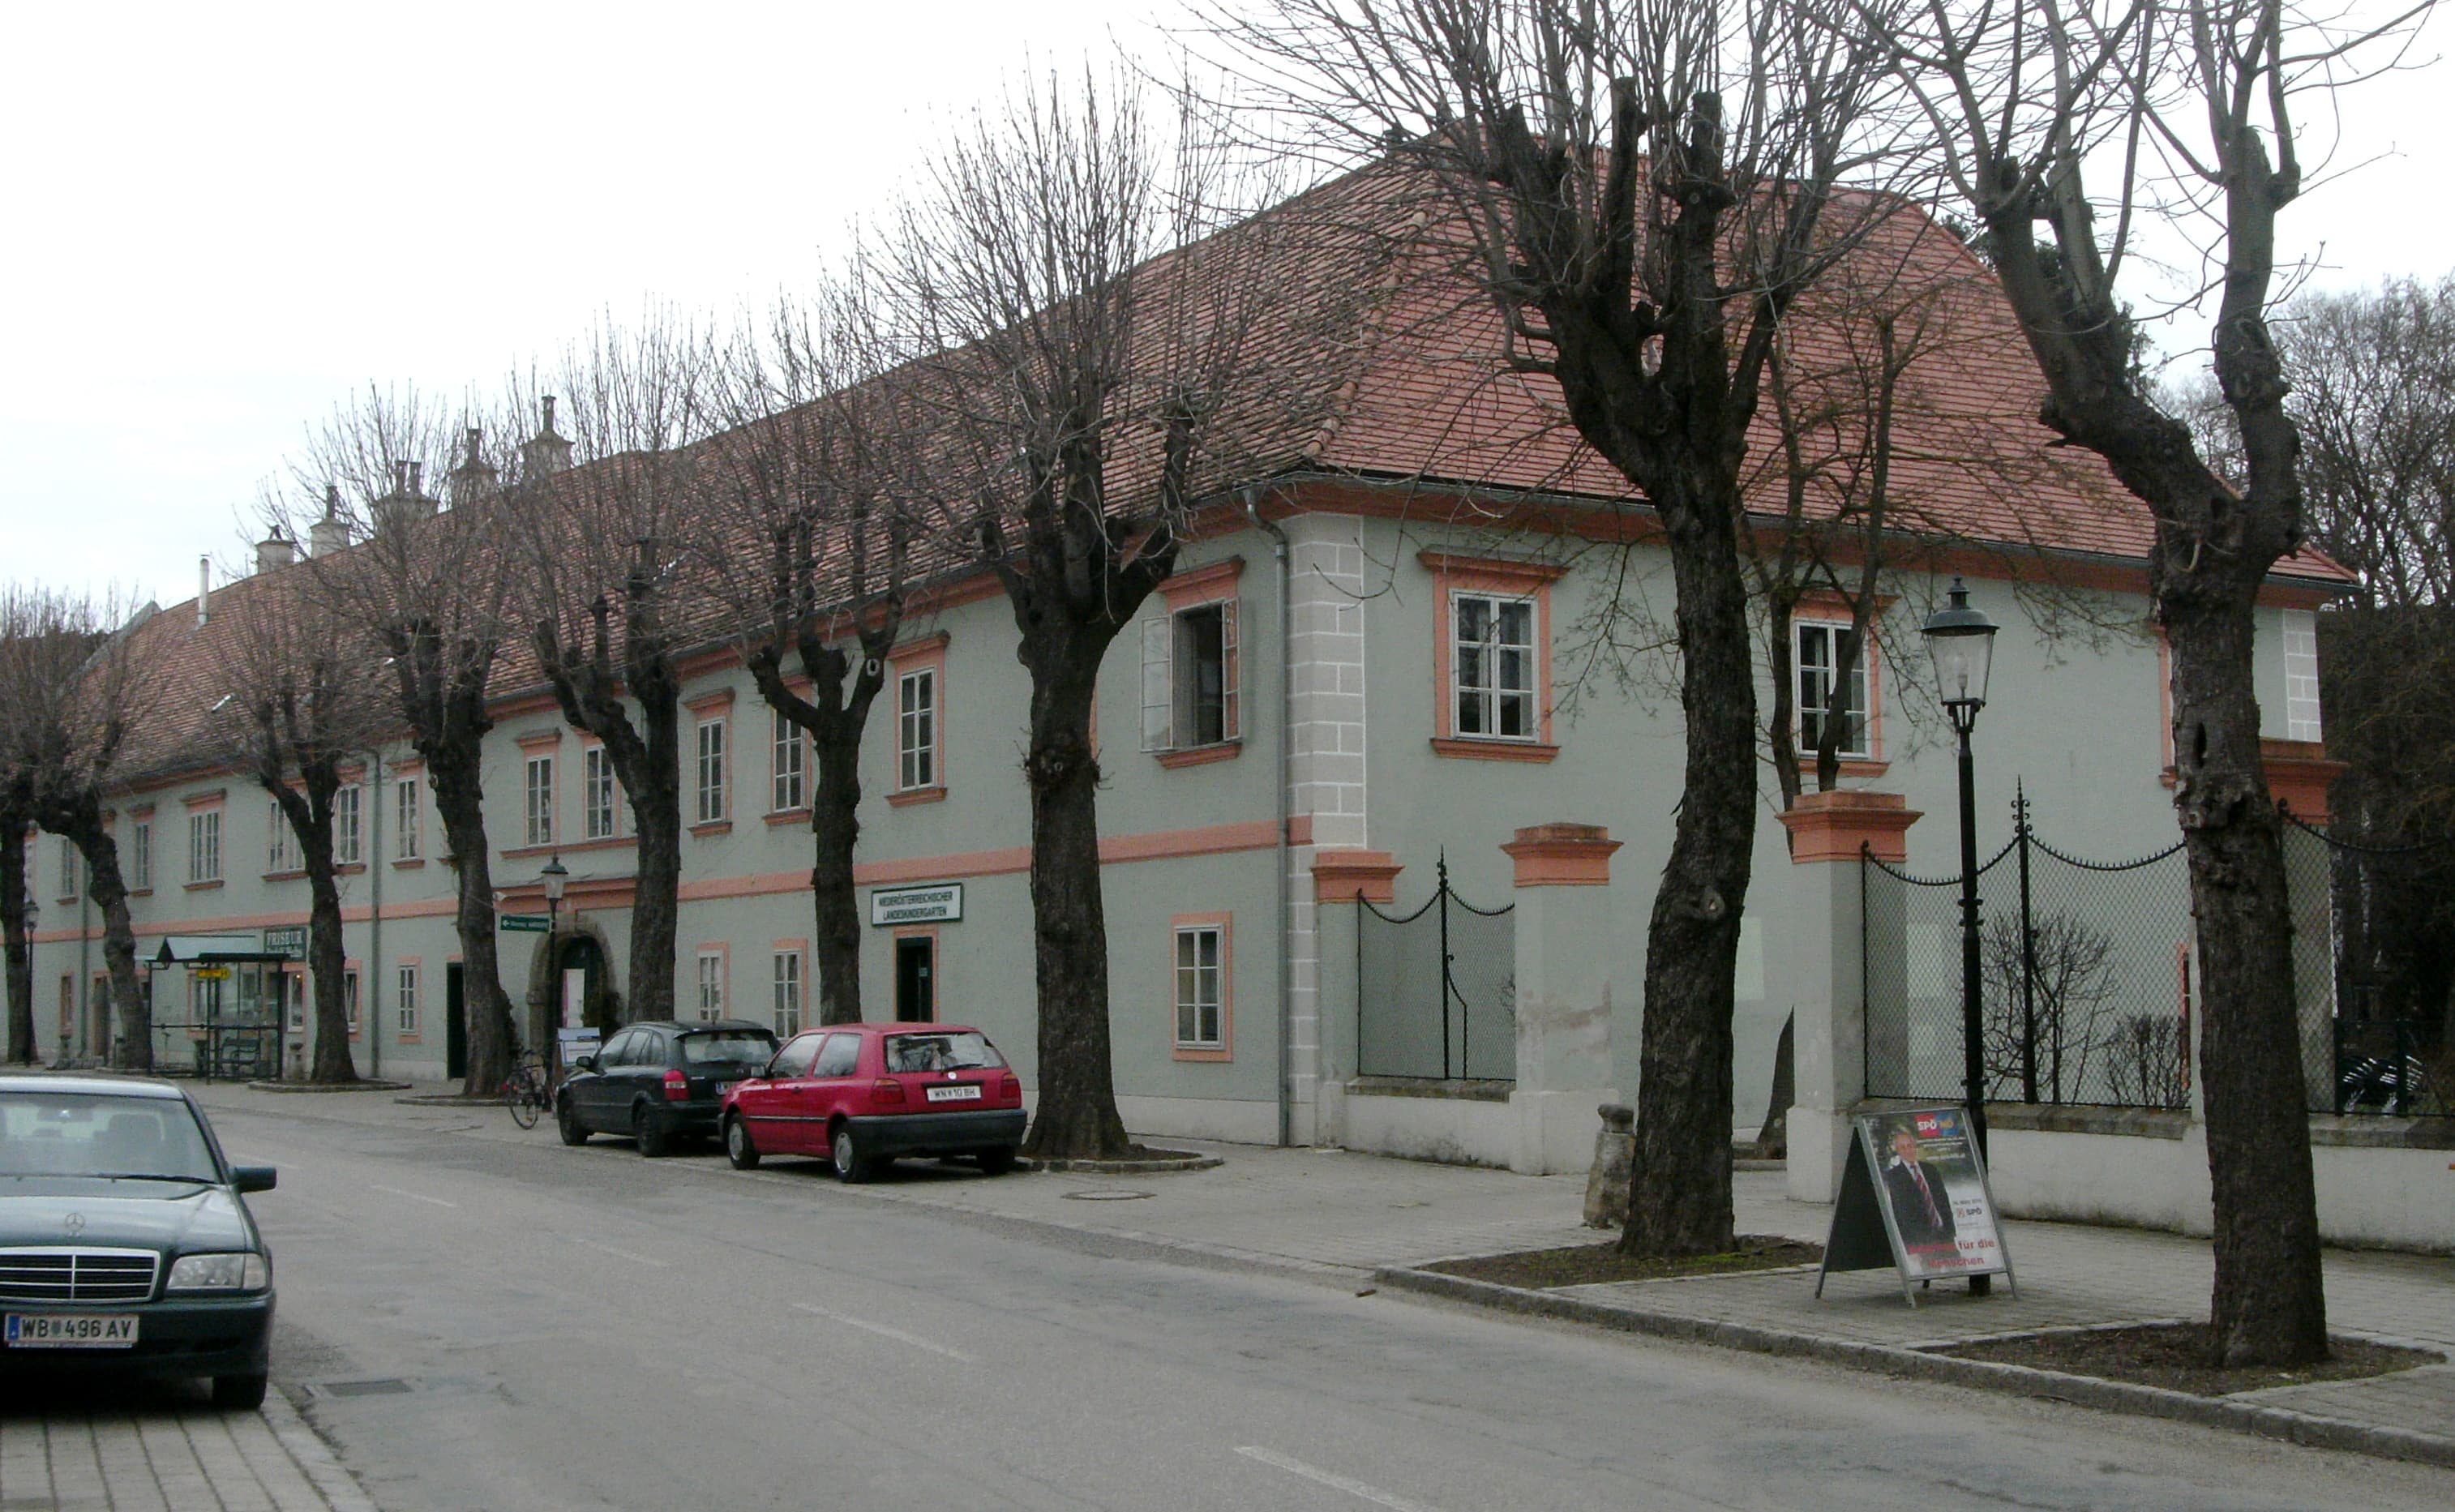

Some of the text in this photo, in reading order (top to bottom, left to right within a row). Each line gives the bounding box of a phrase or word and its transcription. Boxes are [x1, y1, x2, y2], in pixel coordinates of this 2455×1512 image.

[883, 906, 948, 921] LANDESKINDERGARTEN
[266, 931, 302, 946] FRISEUR
[1917, 1119, 1937, 1131] SPÖ
[1965, 1207, 1982, 1216] SPÖ
[1977, 1237, 1995, 1249] die
[22, 1319, 131, 1338] WB 496 AV
